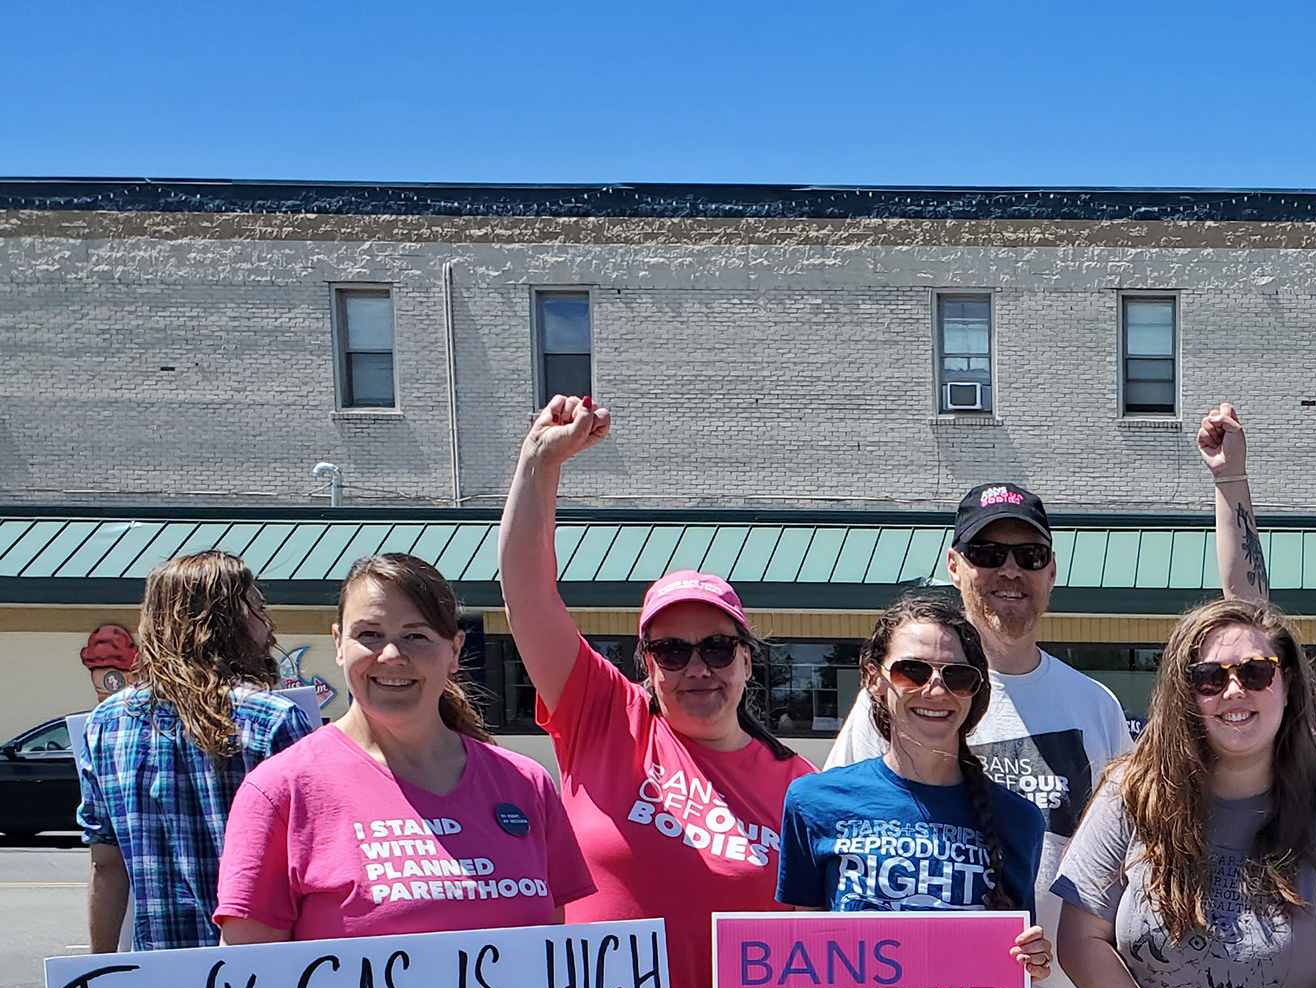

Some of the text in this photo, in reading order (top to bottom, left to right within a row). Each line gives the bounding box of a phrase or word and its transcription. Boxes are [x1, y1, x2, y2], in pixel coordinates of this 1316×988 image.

[1019, 775, 1070, 792] OUR
[639, 778, 780, 853] OFF OUR
[353, 818, 462, 840] I STAND
[627, 800, 770, 866] BODIES
[360, 839, 437, 860] WITH
[365, 857, 495, 881] PLANNED
[371, 878, 548, 905] PARENTHOOD
[741, 940, 903, 985] BANS
